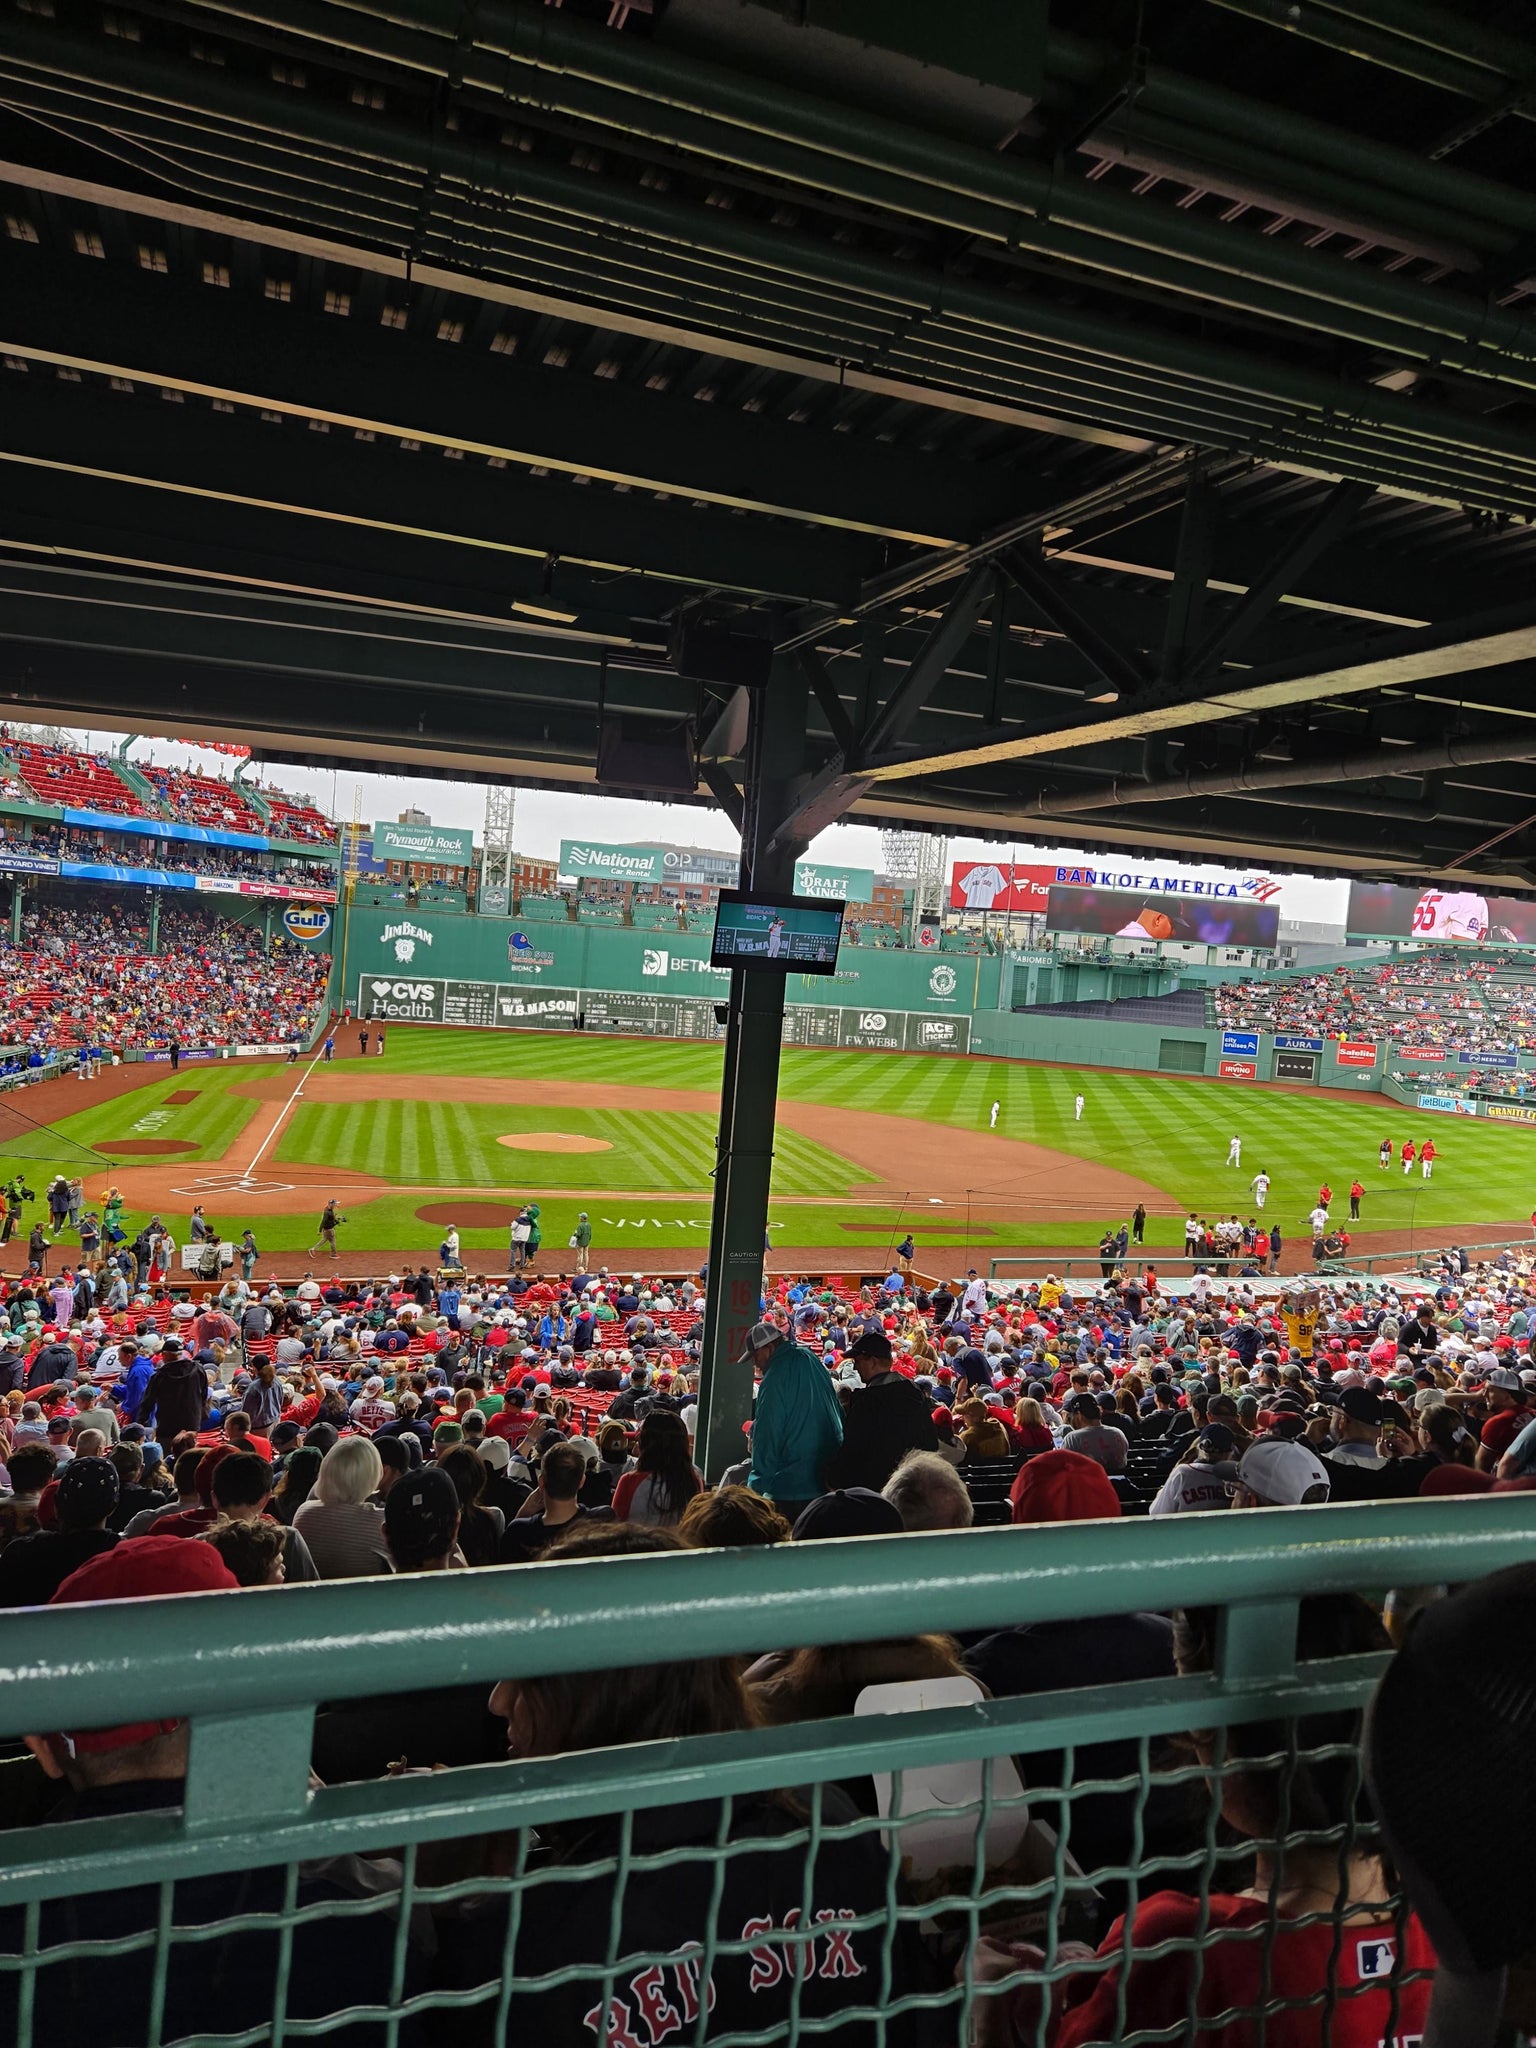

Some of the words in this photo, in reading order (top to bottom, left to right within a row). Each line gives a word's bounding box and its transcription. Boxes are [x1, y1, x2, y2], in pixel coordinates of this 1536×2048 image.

[385, 832, 435, 848] Plymouth
[436, 836, 463, 850] Rock
[610, 867, 624, 875] Car
[625, 869, 651, 878] Rental
[800, 876, 849, 890] DRAFT
[1056, 867, 1112, 886] BANK
[1118, 874, 1143, 889] OF
[1149, 876, 1238, 898] AMERICA
[806, 886, 847, 899] KINGS
[285, 911, 327, 927] Gulf
[380, 924, 402, 943] JIM
[402, 921, 433, 946] BEAM
[1016, 955, 1053, 965] ABIOMED
[511, 964, 534, 973] BIDMC
[391, 982, 435, 1001] CVS
[371, 998, 434, 1018] Health
[859, 1013, 887, 1031] 160
[925, 1022, 954, 1034] ACE
[866, 1036, 898, 1048] WEBB
[925, 1033, 953, 1041] TICKET
[971, 1037, 982, 1045] 379
[1224, 1042, 1247, 1050] cruises
[1338, 1048, 1375, 1058] Safelite
[1224, 1066, 1251, 1075] IRVING
[1356, 1073, 1371, 1082] 420
[1421, 1096, 1452, 1109] jetBlue
[1487, 1105, 1526, 1118] GRANITE
[730, 1279, 753, 1307] 16
[1298, 1324, 1313, 1336] 98
[388, 1337, 398, 1350] 9
[726, 1324, 751, 1355] 17
[105, 1353, 117, 1367] 8
[583, 1939, 716, 2048] RED
[742, 1907, 864, 1994] SOX
